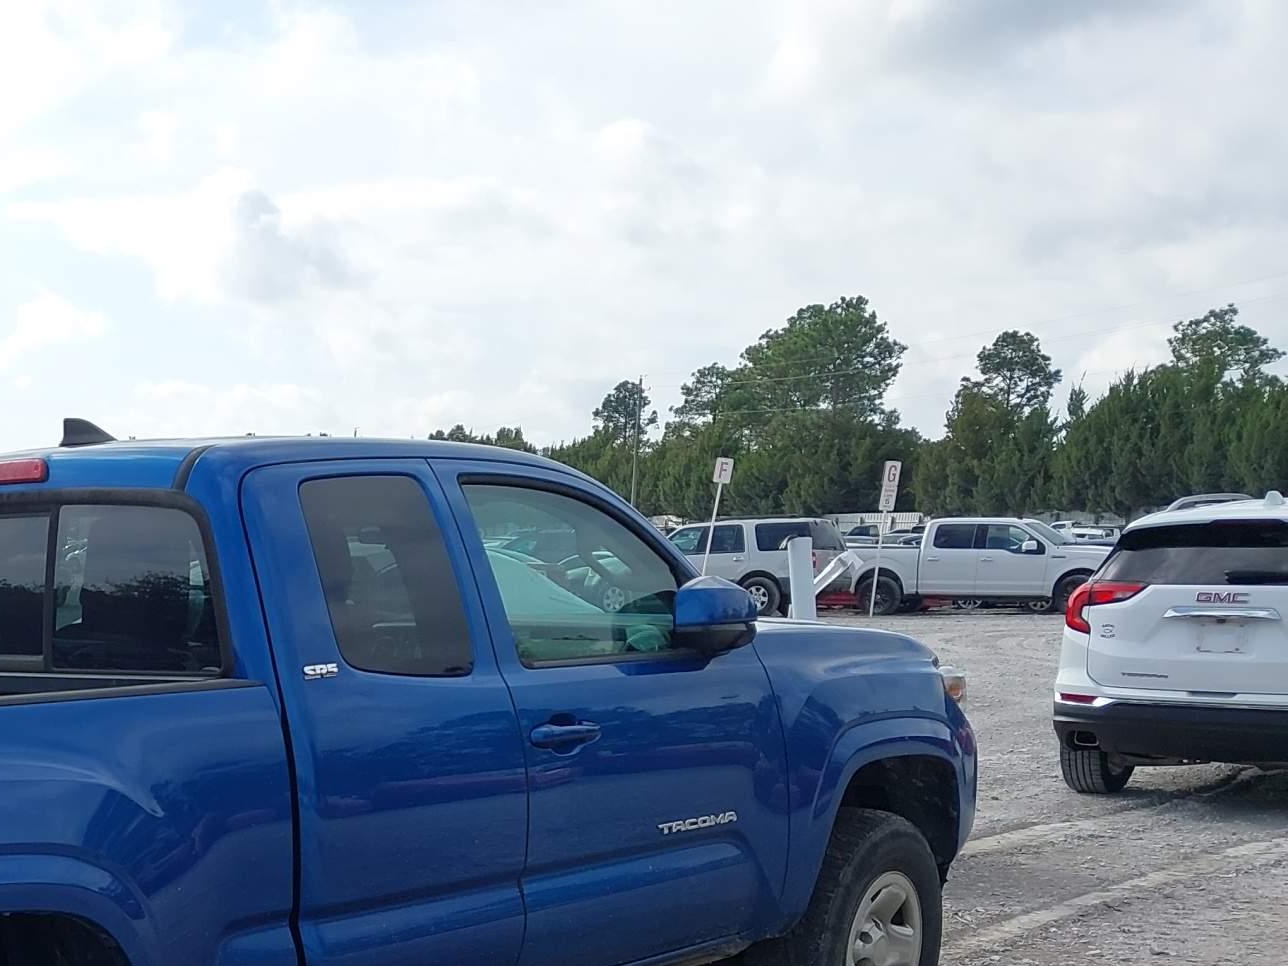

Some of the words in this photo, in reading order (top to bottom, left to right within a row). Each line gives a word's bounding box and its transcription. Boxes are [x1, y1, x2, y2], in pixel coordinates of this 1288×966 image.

[718, 461, 729, 479] F
[887, 464, 898, 483] G
[1195, 591, 1250, 604] GMC
[656, 810, 738, 835] TACOMA
